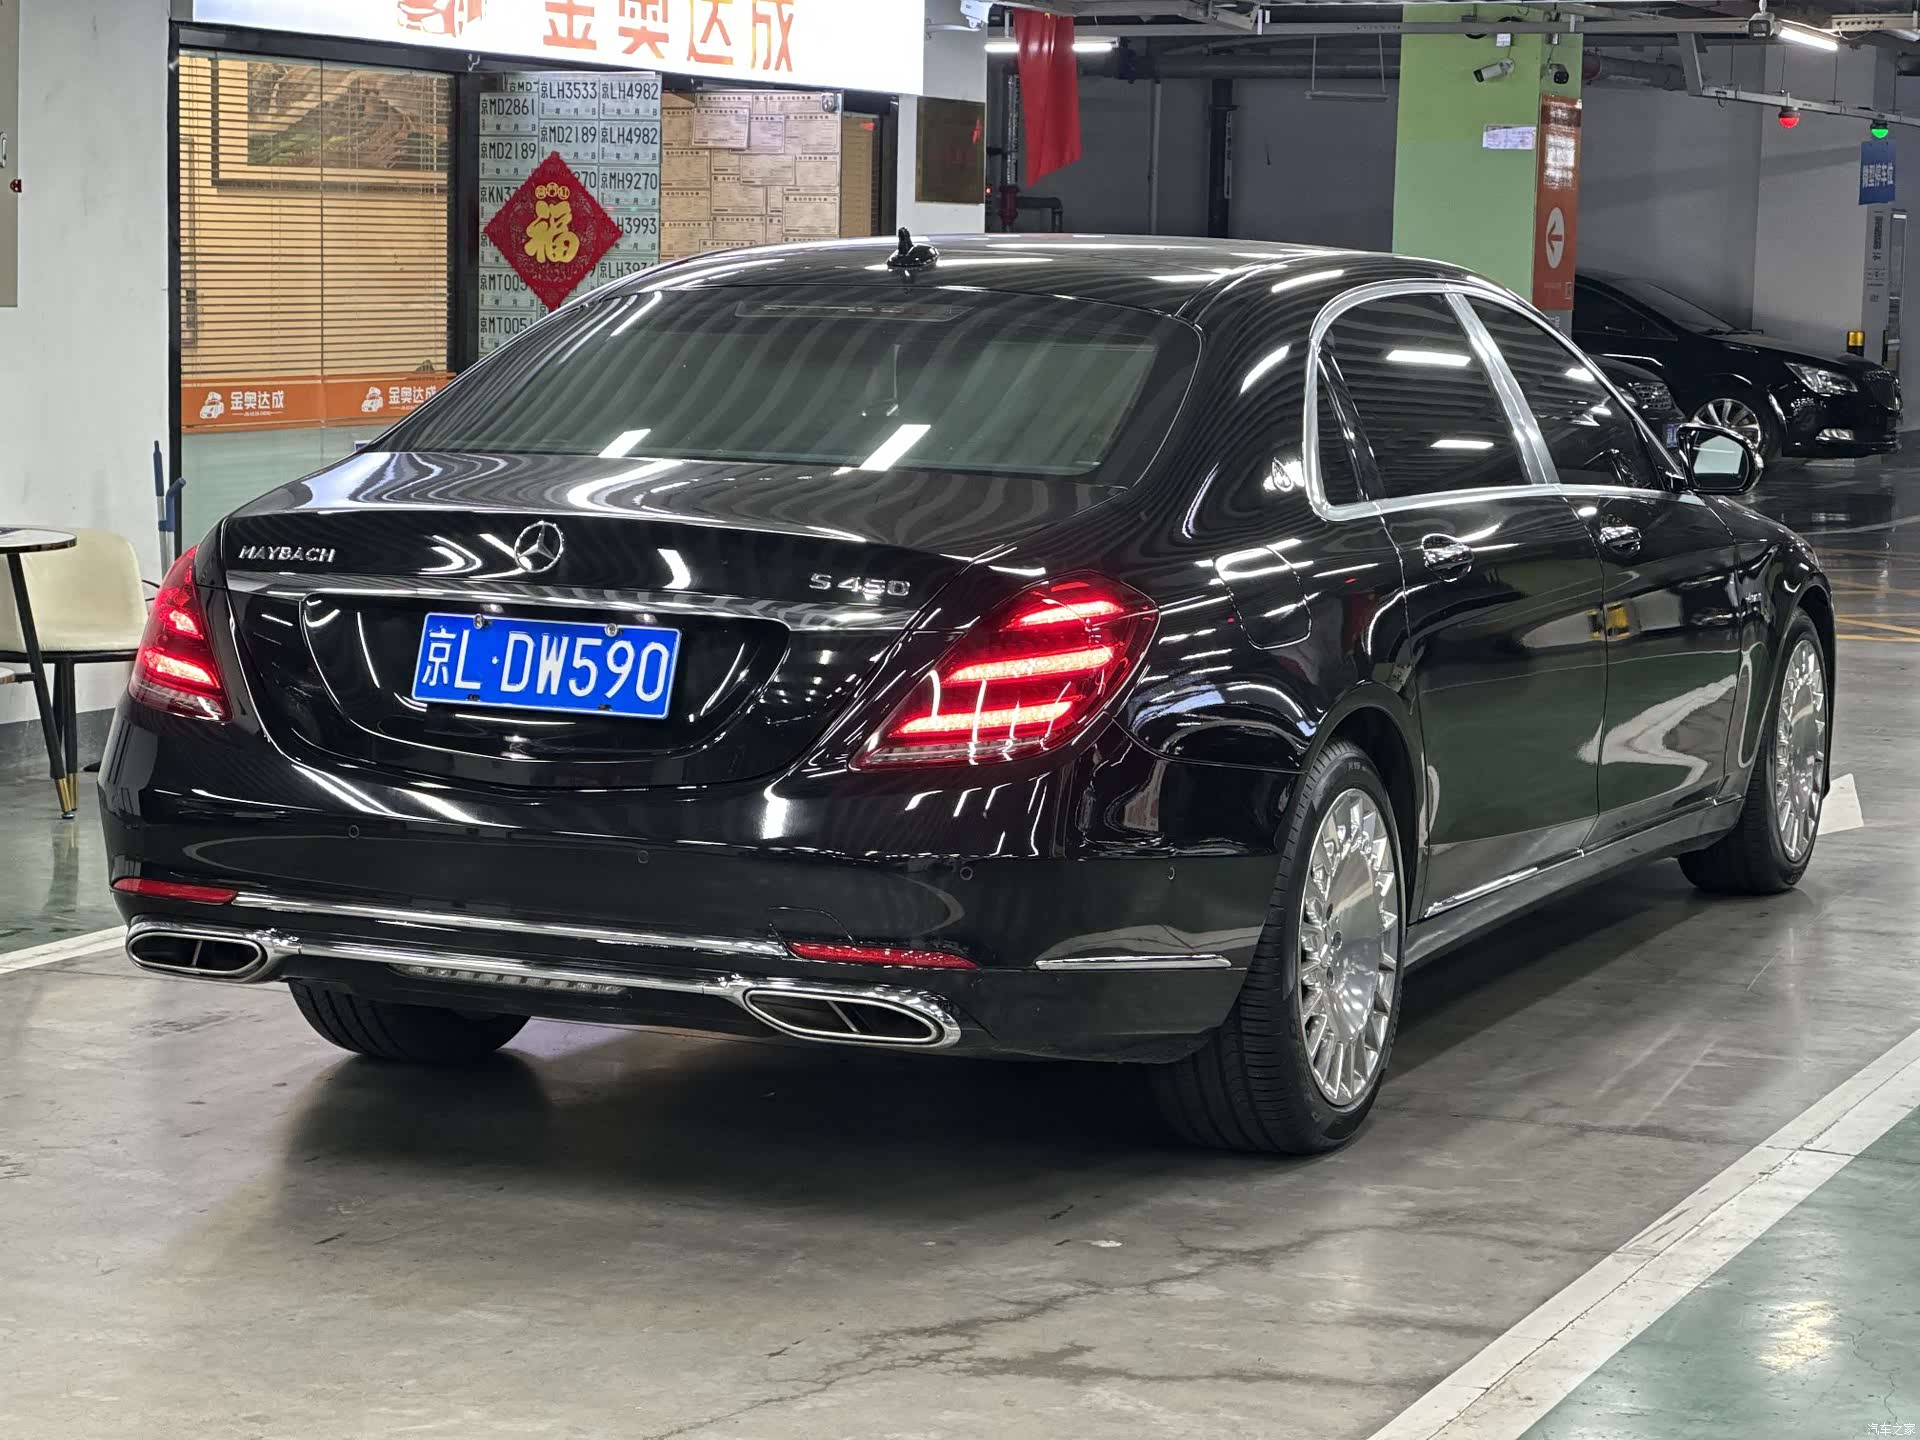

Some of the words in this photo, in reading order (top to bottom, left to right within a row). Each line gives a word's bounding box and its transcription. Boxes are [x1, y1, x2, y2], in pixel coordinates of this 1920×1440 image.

[543, 0, 793, 72] 金奥达成
[541, 82, 597, 99] 京LH3533
[602, 82, 658, 100] 京LH4982
[481, 98, 535, 115] 京MD2861
[541, 126, 597, 143] 京MD2189
[601, 127, 658, 145] 京LH4982
[481, 142, 537, 160] 京MD2189
[601, 173, 658, 190] 京MH9270
[524, 200, 581, 263] 福
[230, 390, 284, 410] 金奥达成
[238, 545, 336, 562] MAYBACH
[809, 573, 832, 590] S
[421, 625, 669, 702] 京L·DW590
